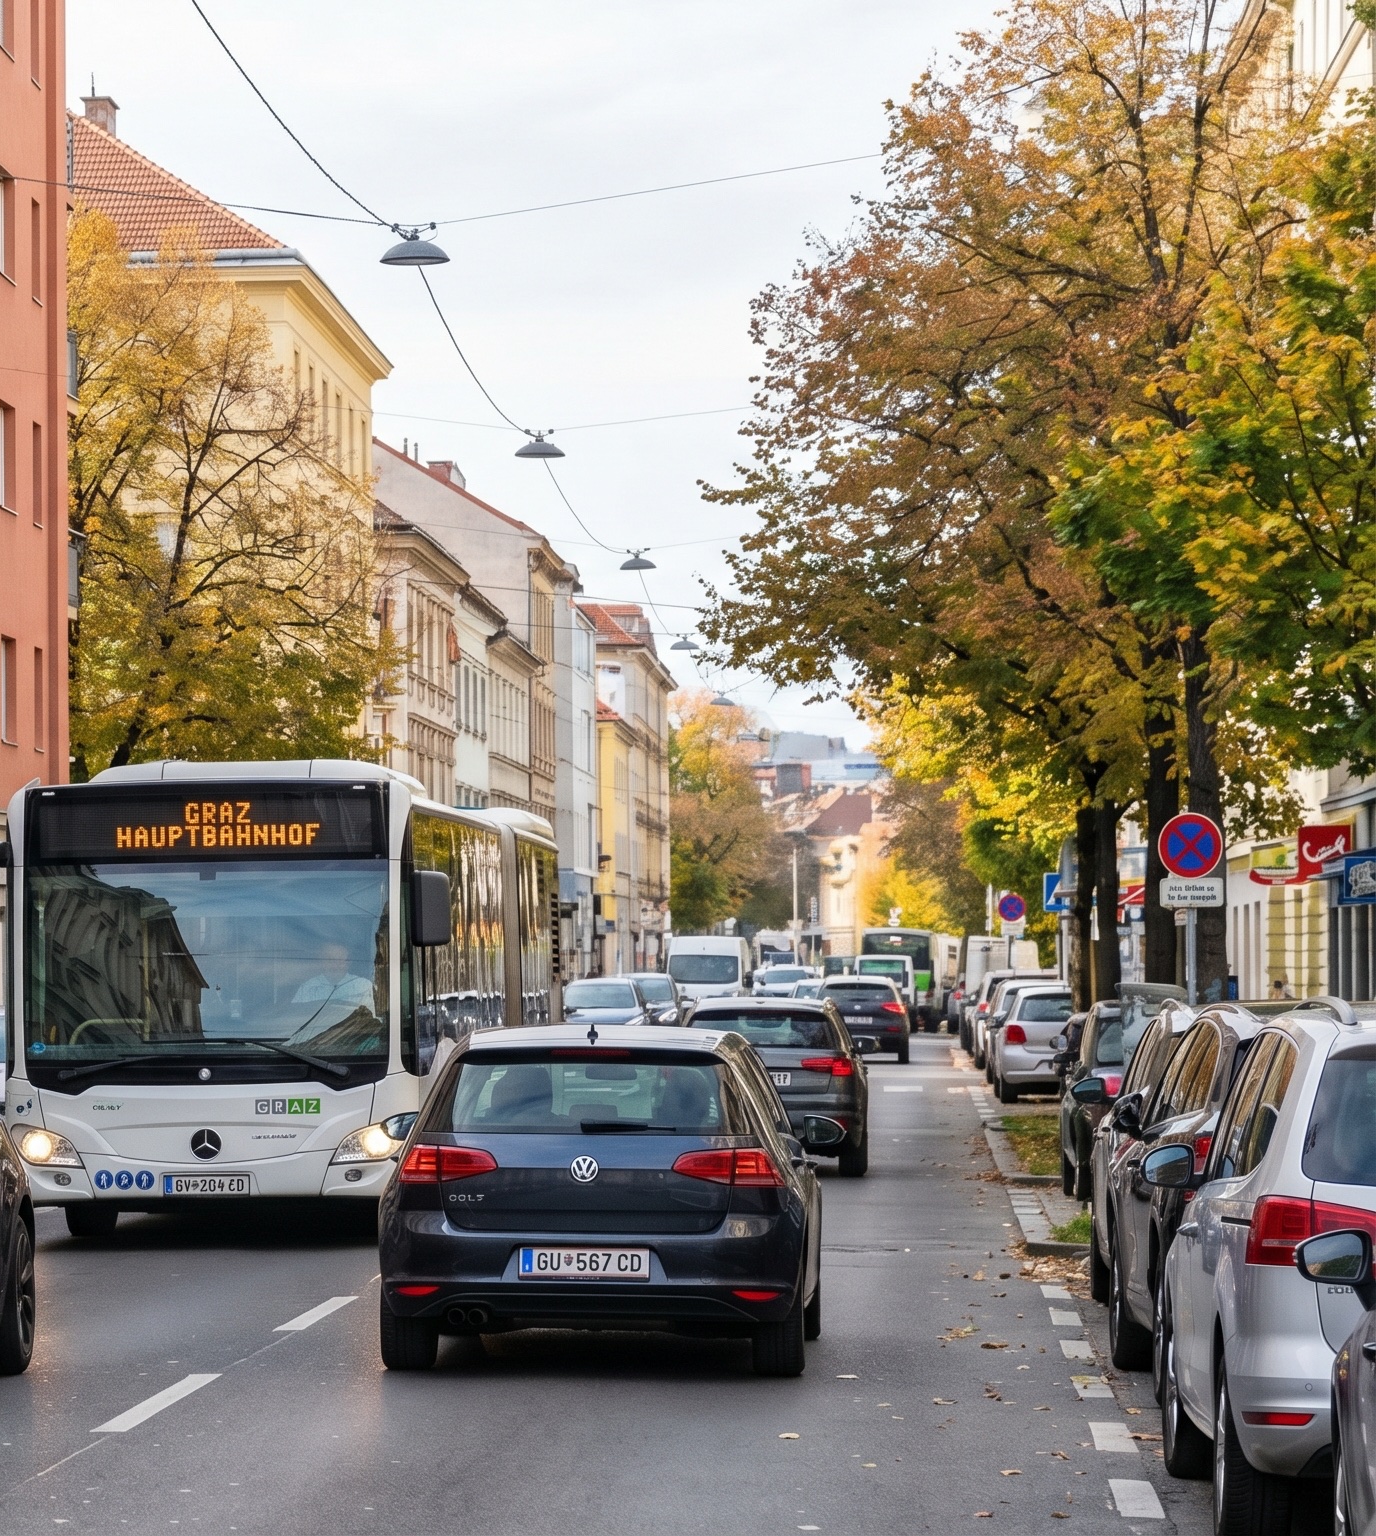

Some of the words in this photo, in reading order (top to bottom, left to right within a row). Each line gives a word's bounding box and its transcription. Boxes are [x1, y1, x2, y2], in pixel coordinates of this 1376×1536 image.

[185, 801, 251, 824] GRAZ
[117, 813, 320, 848] HAUPTBAHNHOF
[255, 1099, 320, 1114] GRAZ
[537, 1252, 561, 1271] GU
[576, 1252, 612, 1272] 567
[617, 1253, 642, 1272] CD
